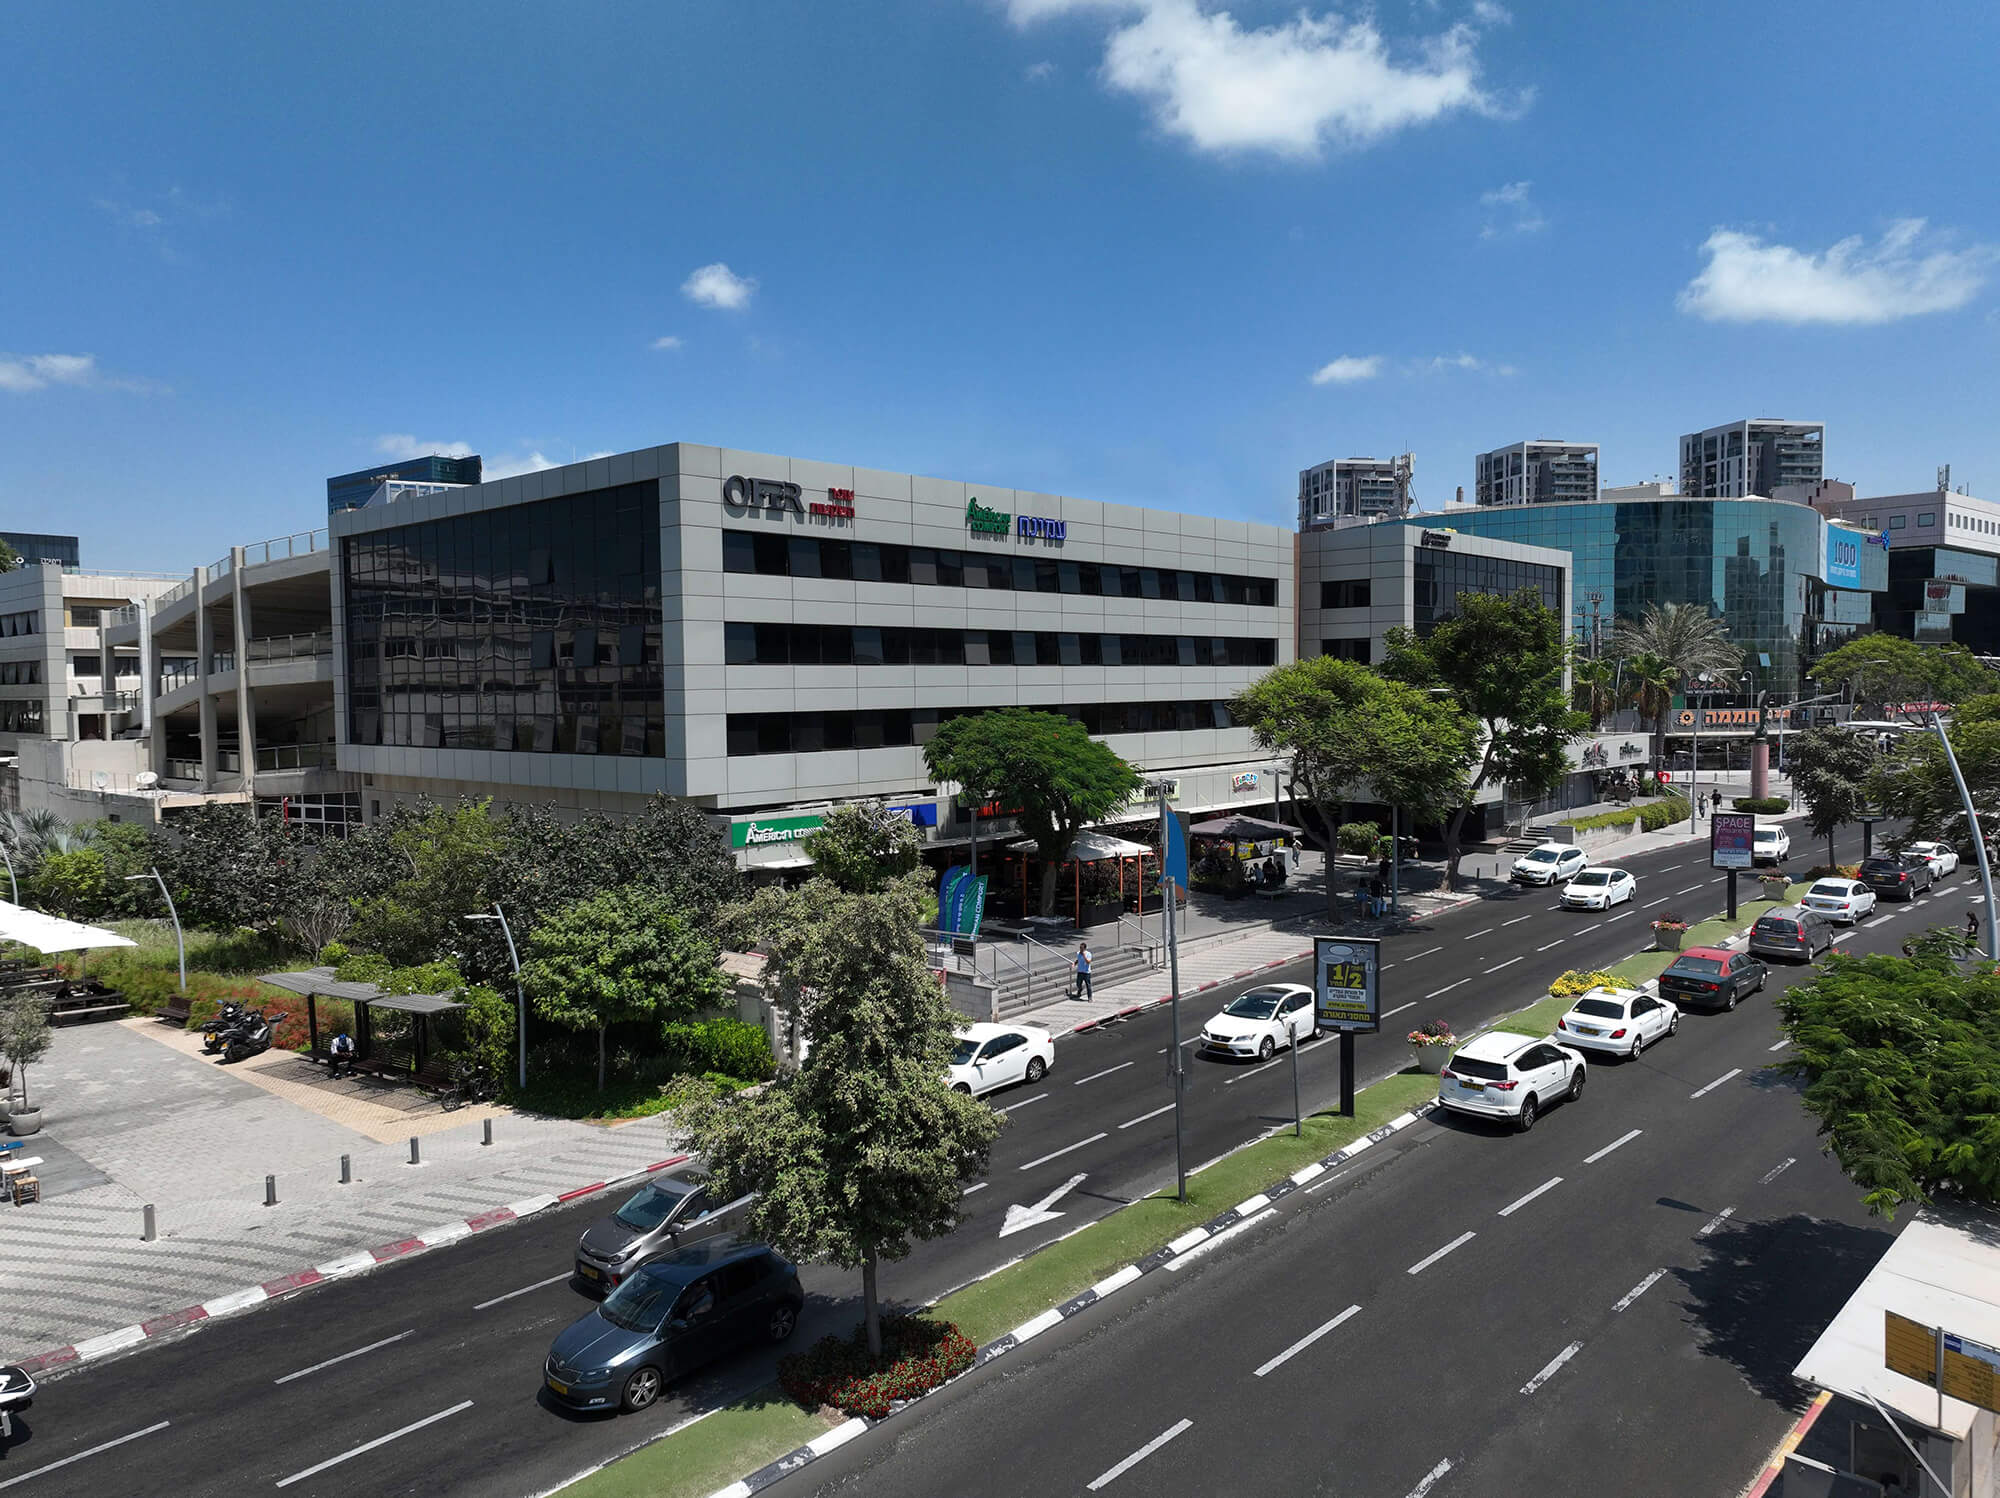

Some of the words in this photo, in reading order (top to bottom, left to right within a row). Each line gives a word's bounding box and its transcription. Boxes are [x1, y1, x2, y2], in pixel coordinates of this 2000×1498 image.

[723, 475, 806, 513] OFER
[1705, 710, 1760, 723] חממה
[1716, 817, 1750, 829] SPACE
